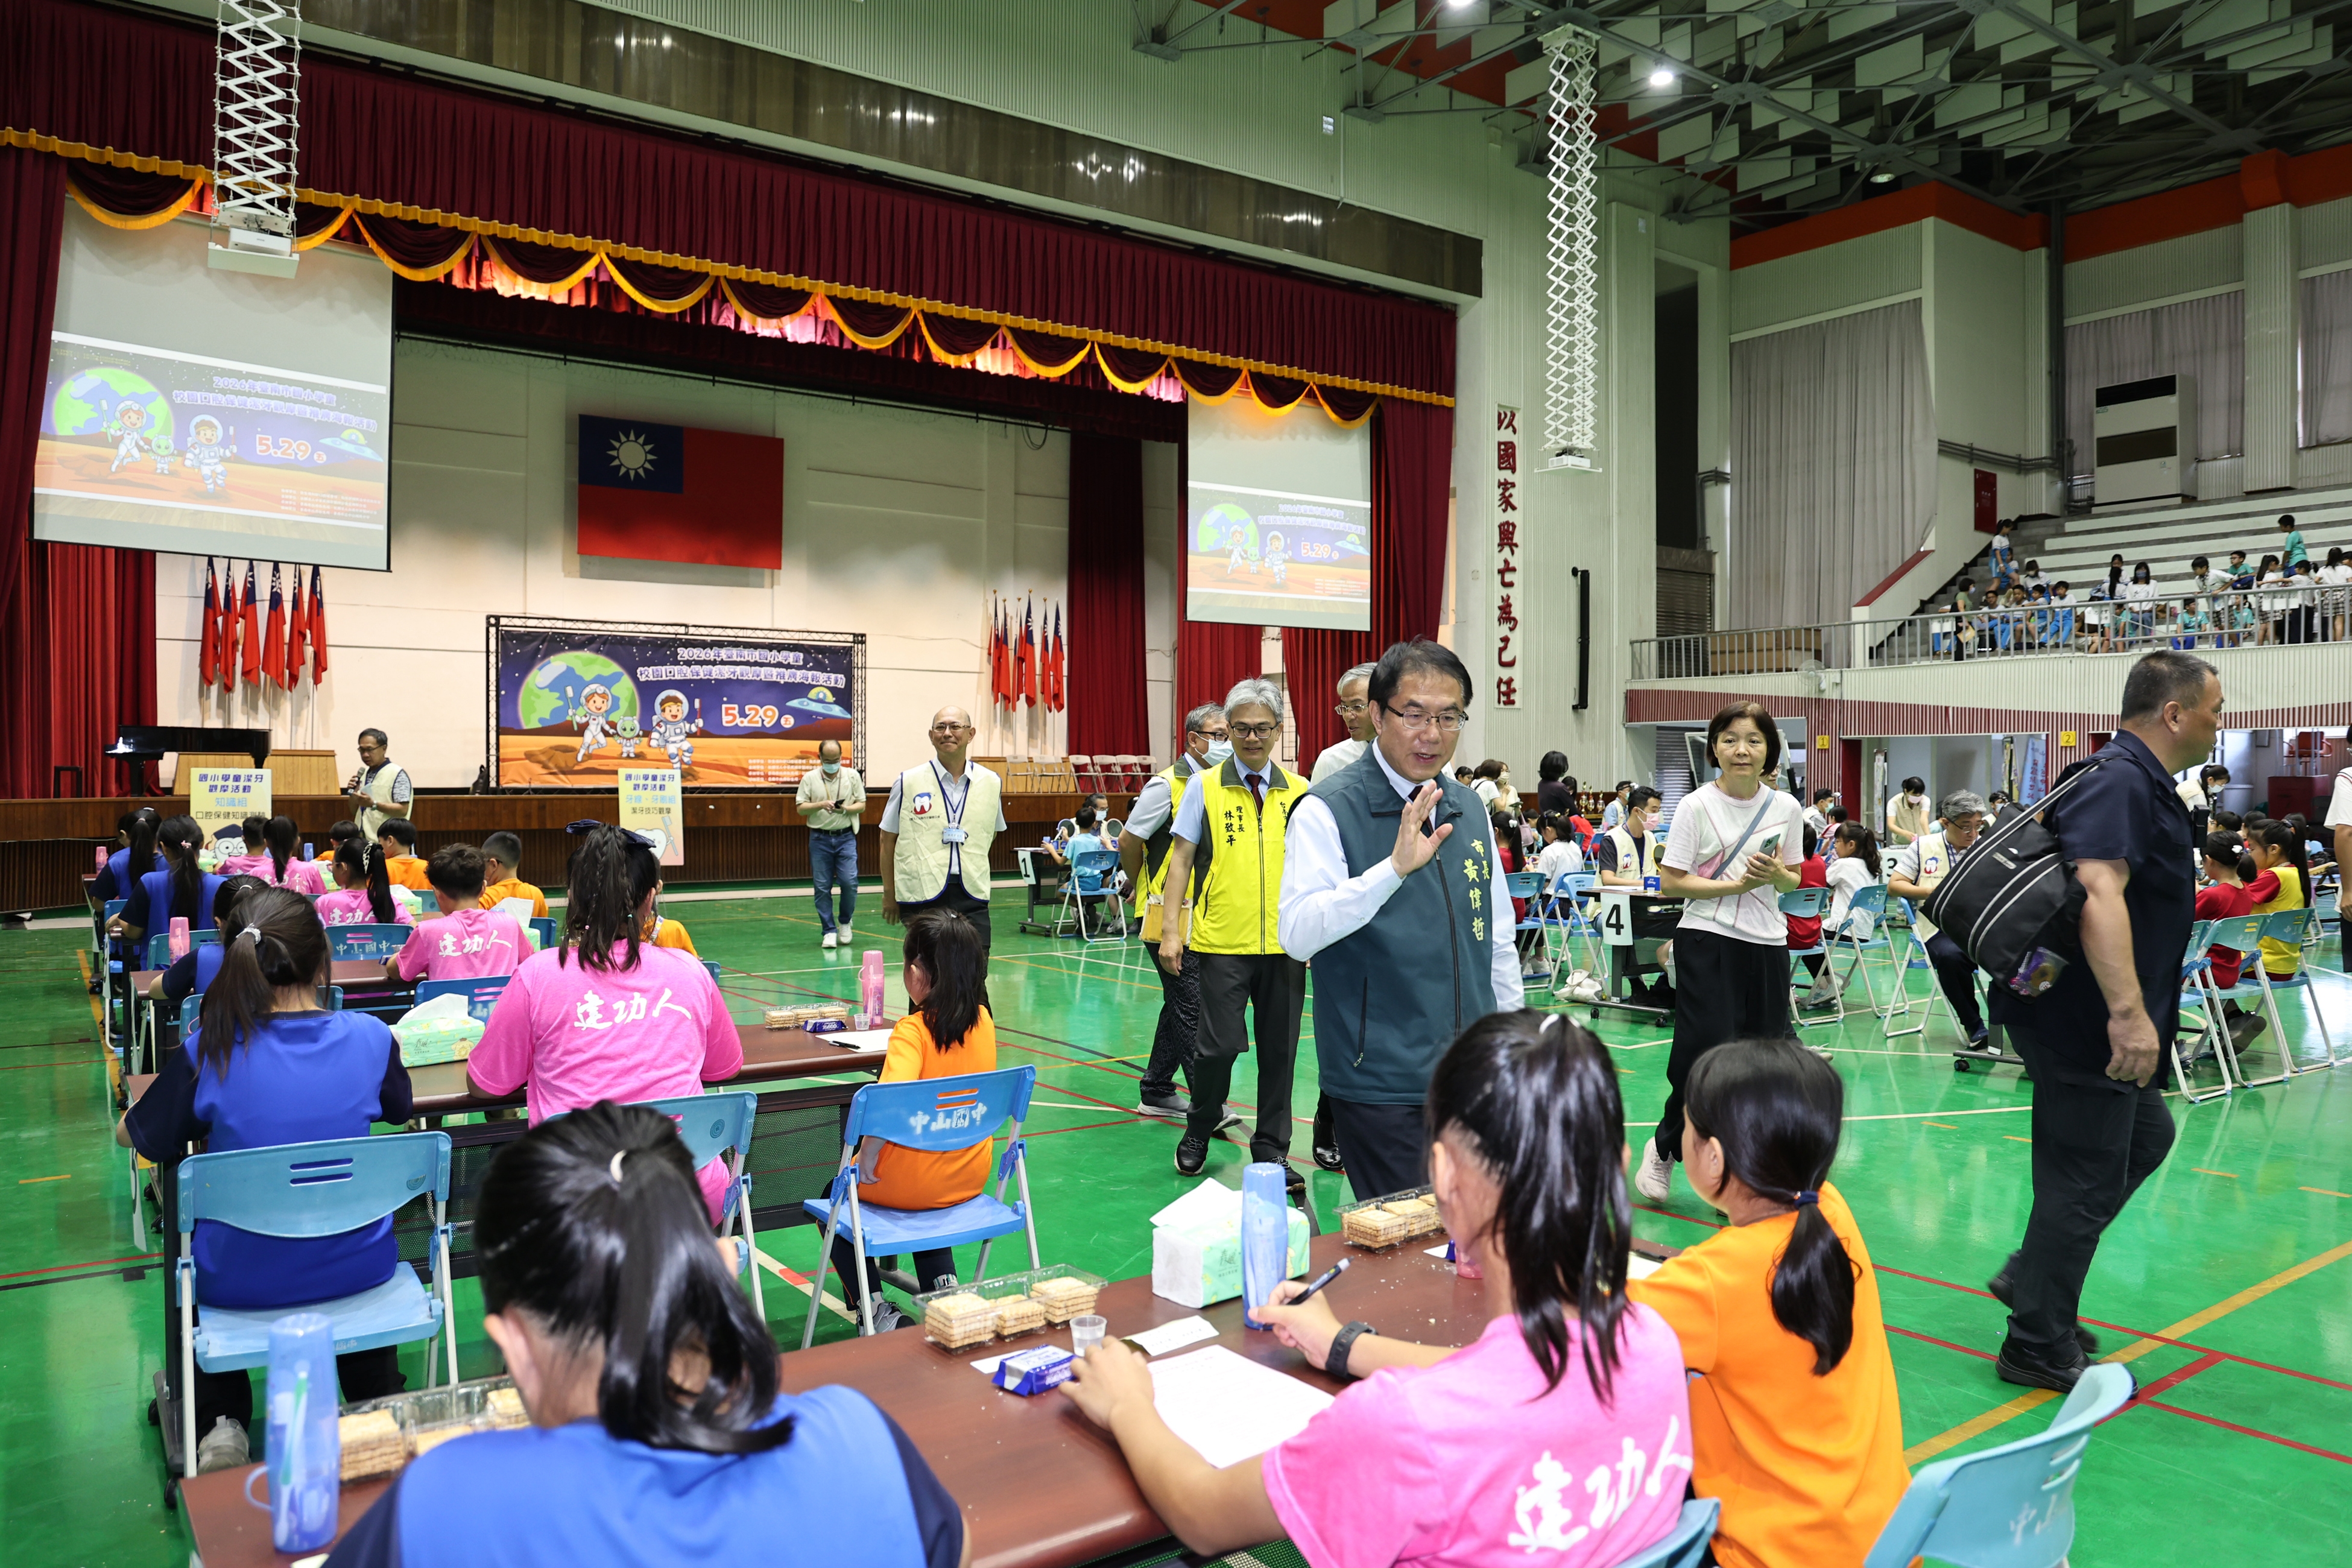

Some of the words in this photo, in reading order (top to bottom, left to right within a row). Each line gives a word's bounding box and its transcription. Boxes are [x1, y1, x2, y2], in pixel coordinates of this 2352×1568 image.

[256, 434, 311, 460] 5.29
[1301, 542, 1330, 558] 5.29
[1497, 410, 1519, 706] 以國家興亡為己任
[677, 647, 804, 665] 2026年臺南市國小學童
[636, 666, 846, 688] 校園口腔保健潔牙觀摩暨推廣海報活動
[722, 704, 779, 727] 5.29
[198, 773, 264, 783] 國小學童潔牙
[209, 785, 251, 793] 觀摩活動
[215, 797, 248, 808] 知識組
[1224, 810, 1236, 847] 林致平
[1236, 806, 1245, 832] 理事長
[1021, 858, 1031, 878] 1
[1470, 839, 1490, 880] 市長
[1886, 858, 1898, 877] 3
[1463, 858, 1485, 941] 黃偉哲
[1605, 903, 1625, 936] 4
[336, 940, 391, 956] 中山國中
[909, 1102, 988, 1135] 中山國中
